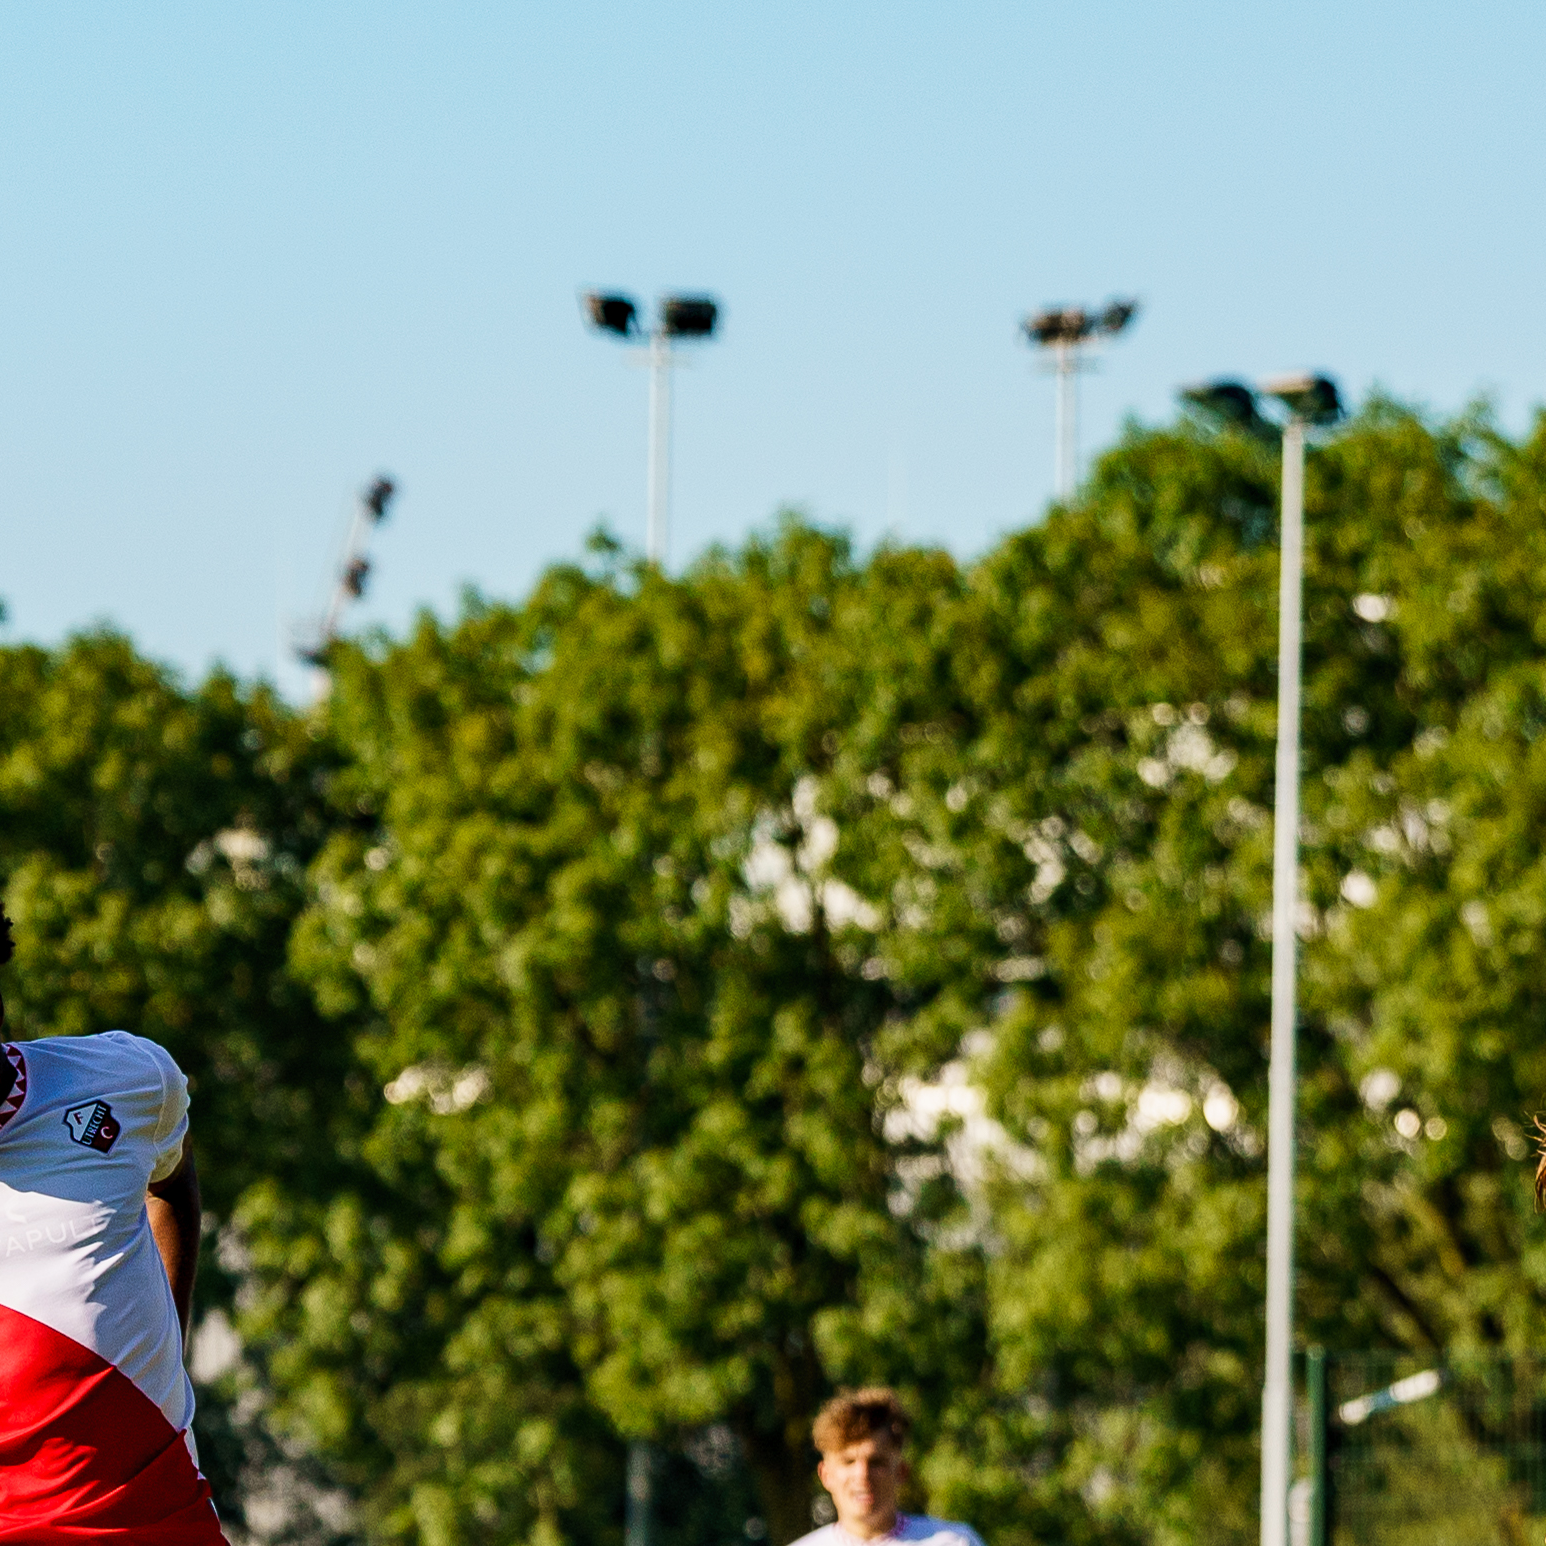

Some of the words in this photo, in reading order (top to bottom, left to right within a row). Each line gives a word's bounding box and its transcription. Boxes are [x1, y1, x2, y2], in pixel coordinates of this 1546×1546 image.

[73, 1111, 83, 1125] F
[81, 1104, 107, 1146] UTRECHT
[100, 1125, 113, 1139] C
